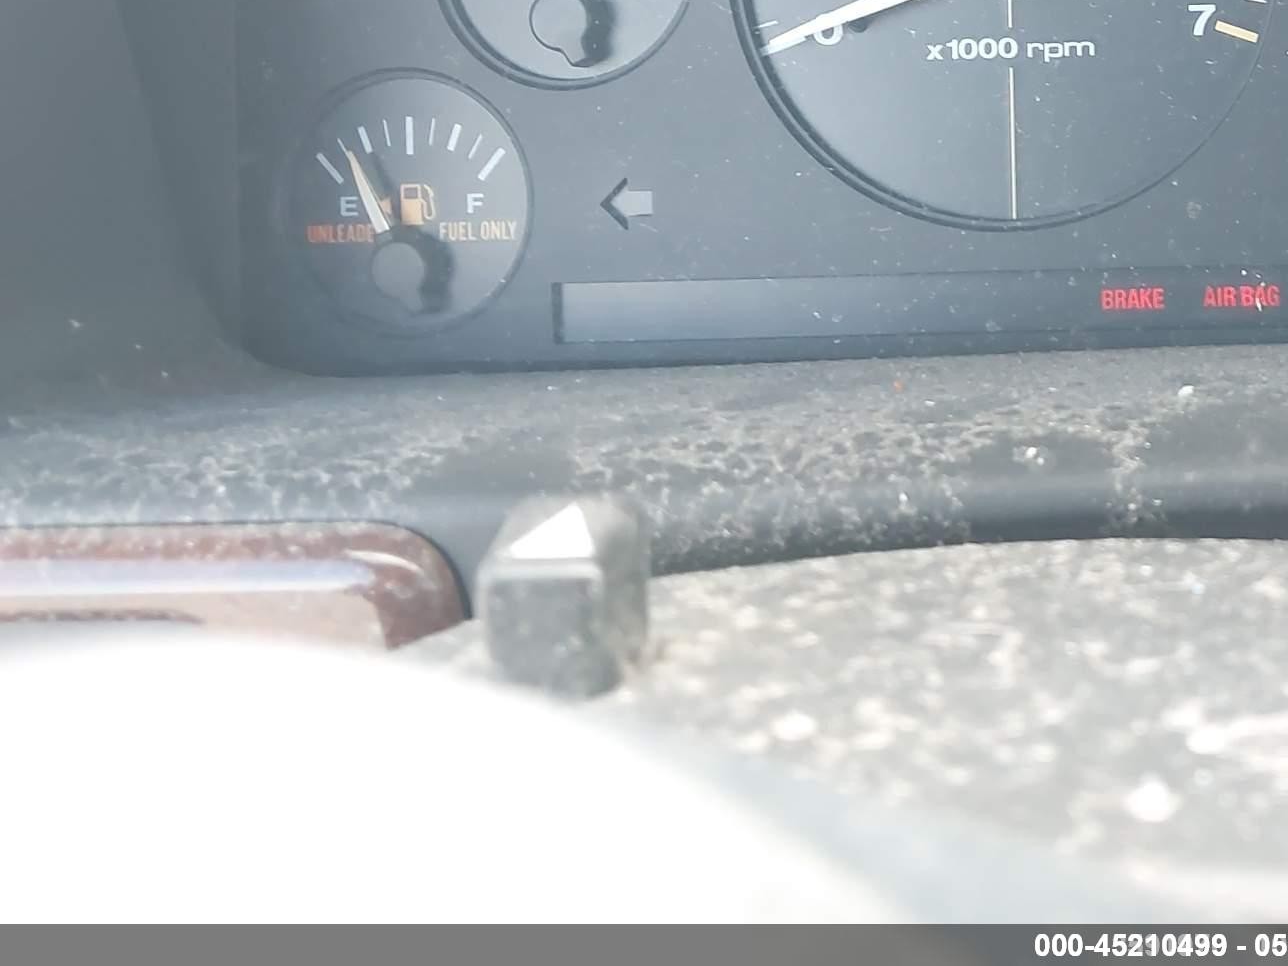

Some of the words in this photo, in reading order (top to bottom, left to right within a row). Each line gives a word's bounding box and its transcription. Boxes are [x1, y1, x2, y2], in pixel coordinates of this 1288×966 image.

[1187, 4, 1217, 37] 7
[926, 37, 1019, 61] x1000
[1026, 39, 1096, 63] rpm
[340, 195, 360, 217] E
[466, 192, 484, 214] F
[439, 221, 477, 242] FUEL
[480, 219, 518, 241] ONLY
[1101, 287, 1166, 311] BRAKE
[1203, 284, 1237, 308] AIR
[1240, 284, 1281, 308] BAG
